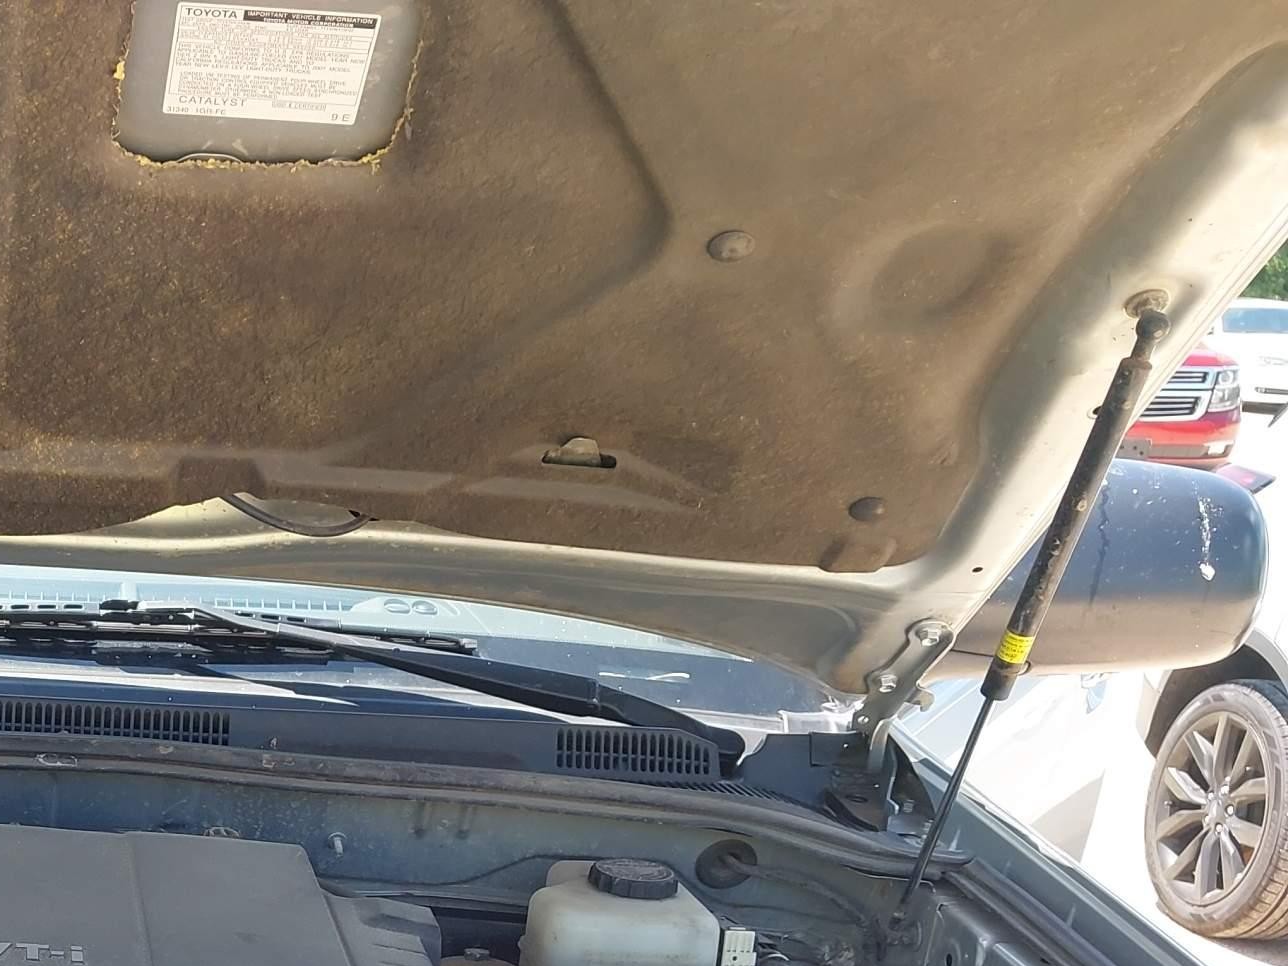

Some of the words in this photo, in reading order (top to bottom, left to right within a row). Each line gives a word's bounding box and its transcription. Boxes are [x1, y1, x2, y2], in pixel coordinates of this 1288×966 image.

[185, 7, 238, 19] TOYOTA
[247, 11, 288, 19] IMPORTANT
[324, 16, 374, 25] INFORMATION
[179, 95, 247, 107] CATALYST
